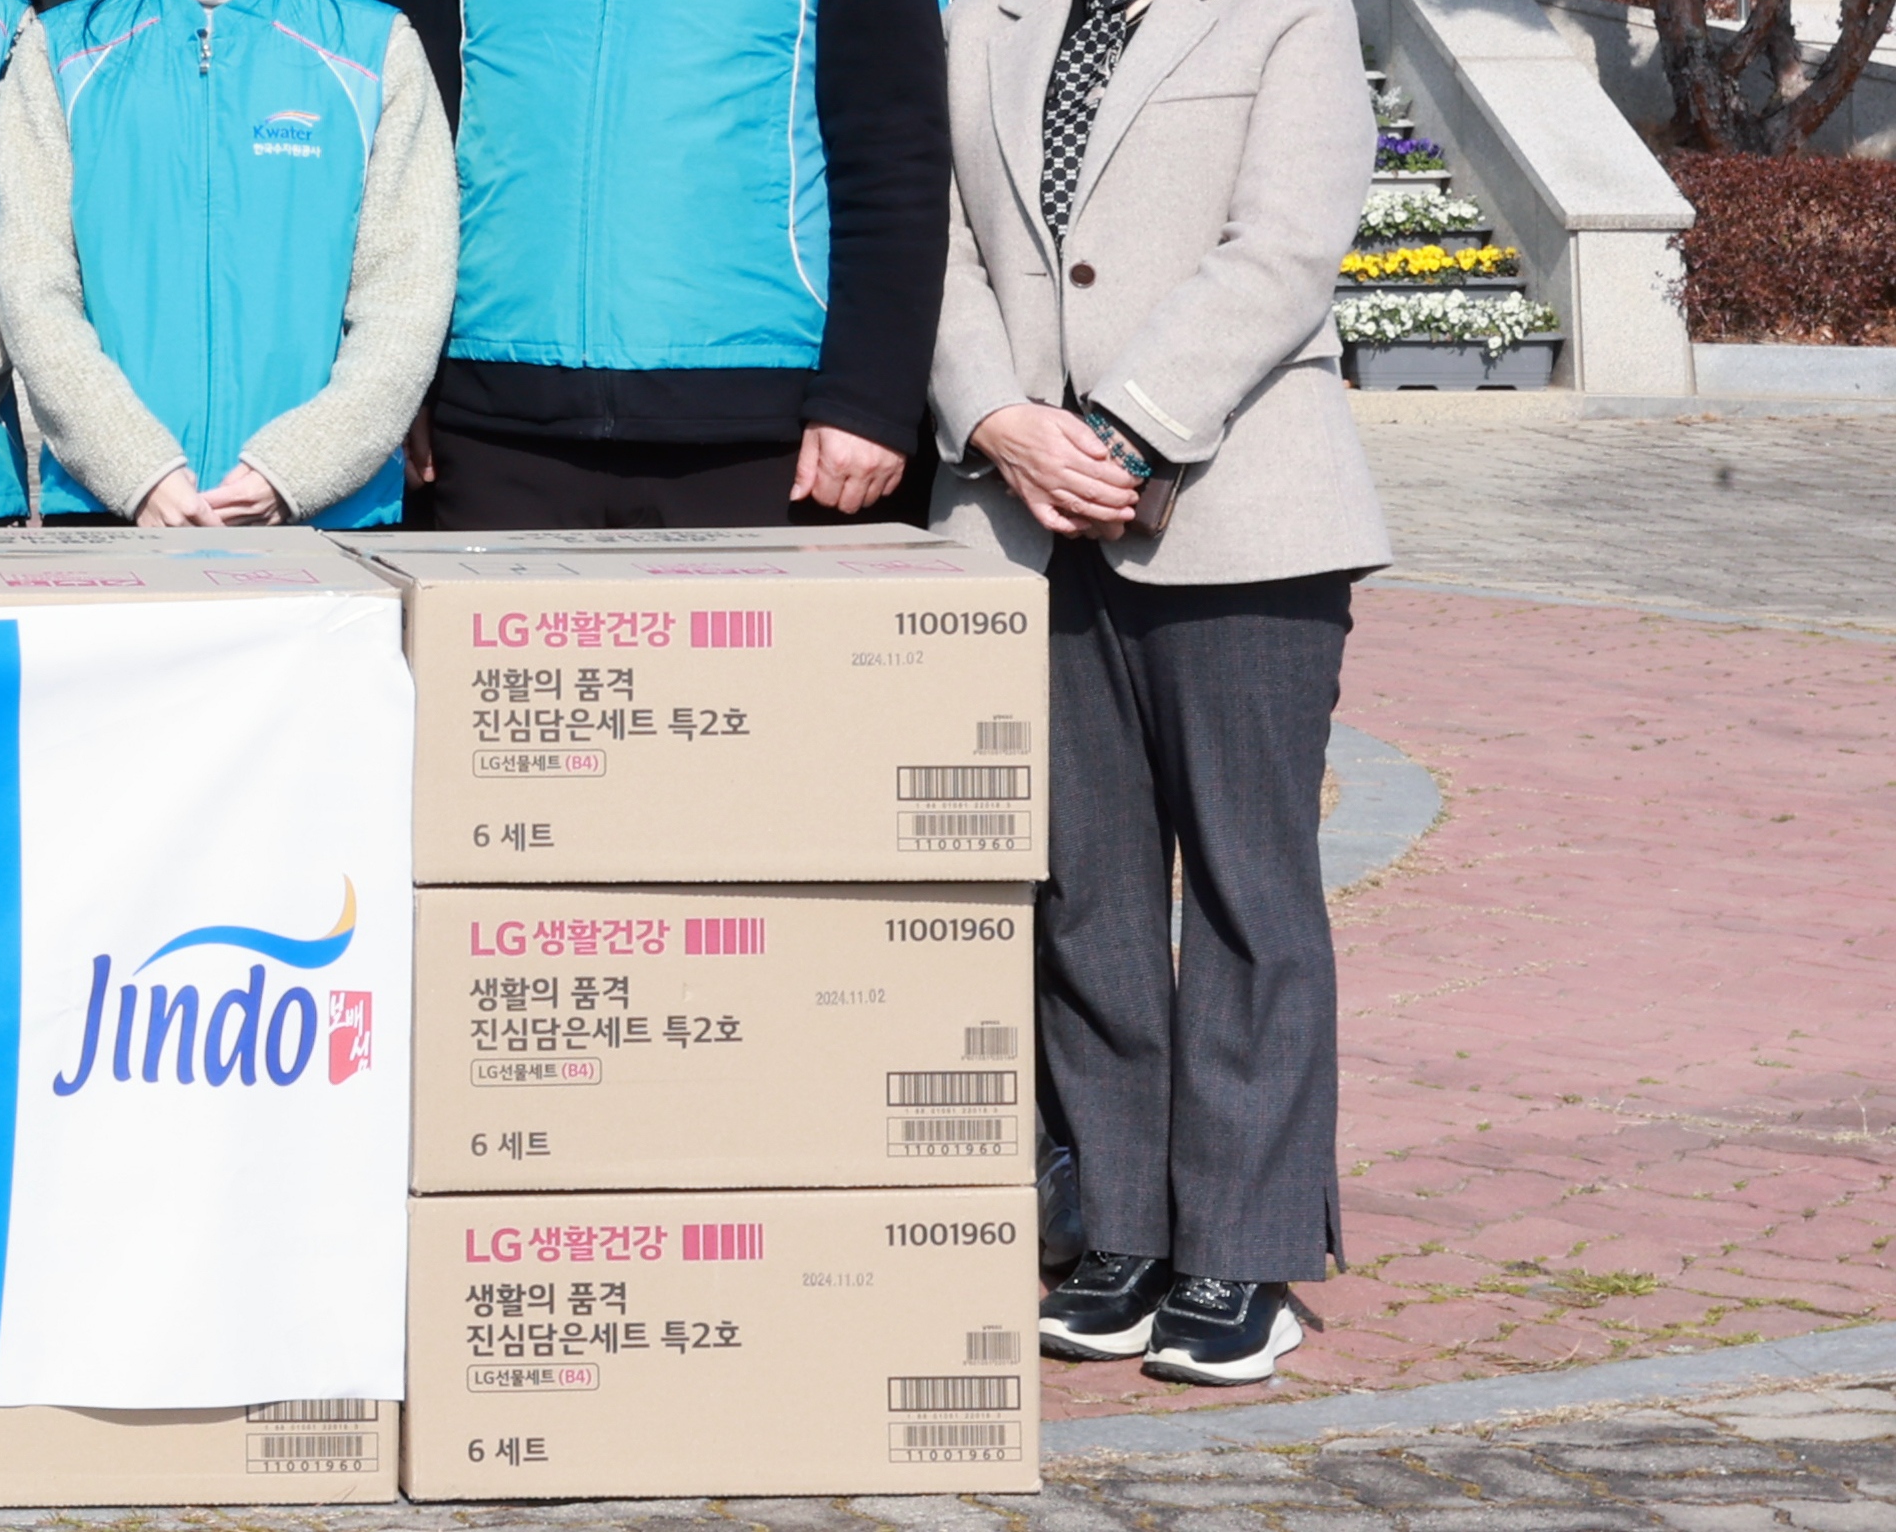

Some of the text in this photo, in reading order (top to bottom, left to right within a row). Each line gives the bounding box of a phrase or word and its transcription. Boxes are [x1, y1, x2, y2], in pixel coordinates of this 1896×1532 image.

[895, 611, 1028, 635] 11001960
[472, 667, 634, 703] 생활의 품격
[473, 707, 750, 743] 진심담은세트 특2호
[473, 822, 555, 852] 6 세트
[915, 839, 1014, 850] 11001960
[885, 917, 1015, 942] 11001960
[470, 975, 629, 1012] 생활의 품격
[52, 953, 317, 1097] Jindo
[470, 1015, 743, 1052] 진심담은세트 특2호
[471, 1131, 551, 1161] 6 세트
[905, 1144, 1002, 1155] 11001960
[885, 1221, 1016, 1247] 11001960
[466, 1281, 626, 1318] 생활의 품격
[466, 1320, 742, 1358] 진심담은세트 특2호
[264, 1460, 362, 1472] 11001960
[468, 1437, 549, 1467] 6 세트
[907, 1449, 1005, 1461] 11001960
